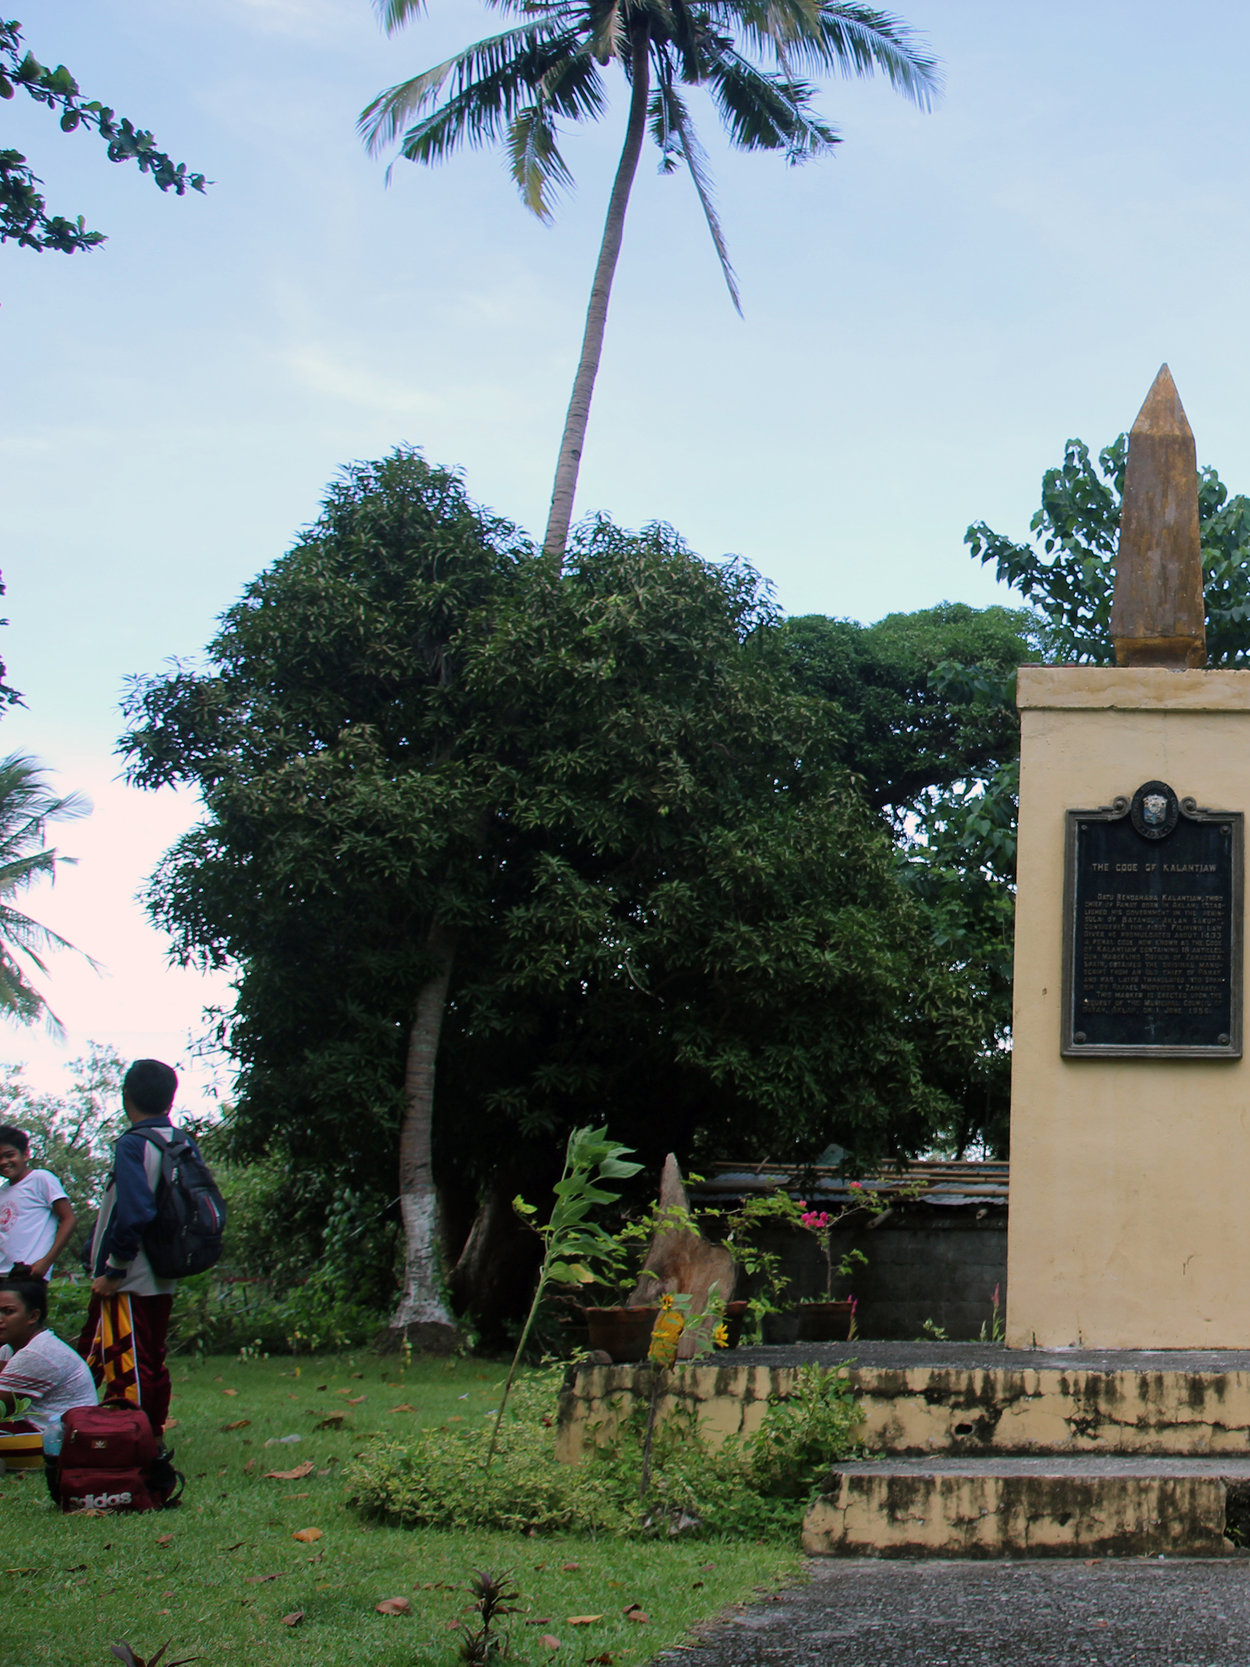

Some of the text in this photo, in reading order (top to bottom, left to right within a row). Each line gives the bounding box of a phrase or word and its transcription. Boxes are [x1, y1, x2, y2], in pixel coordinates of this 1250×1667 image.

[1092, 863, 1217, 872] THE CODE OF KALANTIAW
